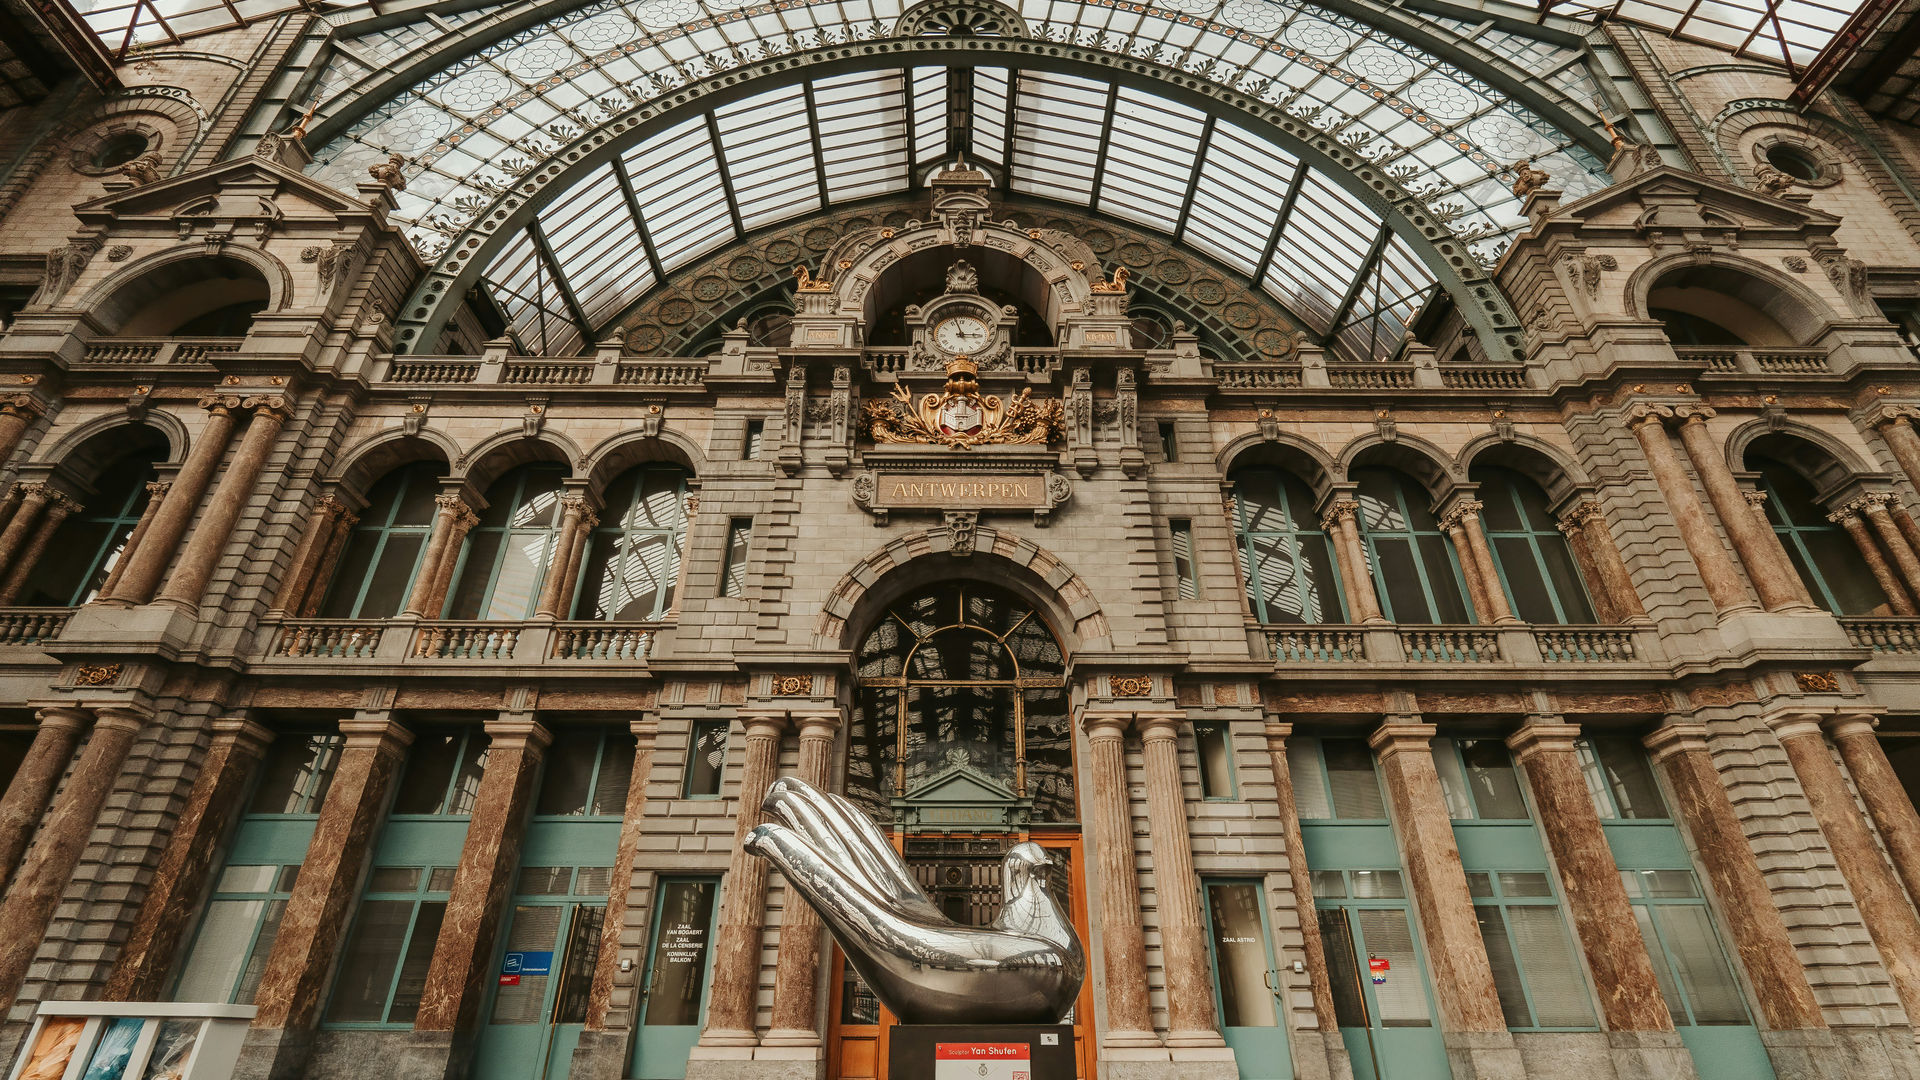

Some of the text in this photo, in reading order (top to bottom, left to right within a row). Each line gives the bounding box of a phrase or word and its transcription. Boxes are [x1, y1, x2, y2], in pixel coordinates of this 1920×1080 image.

[892, 482, 1028, 498] ANTWERPEN
[971, 1047, 986, 1055] Yan
[988, 1047, 1017, 1055] Shufen
